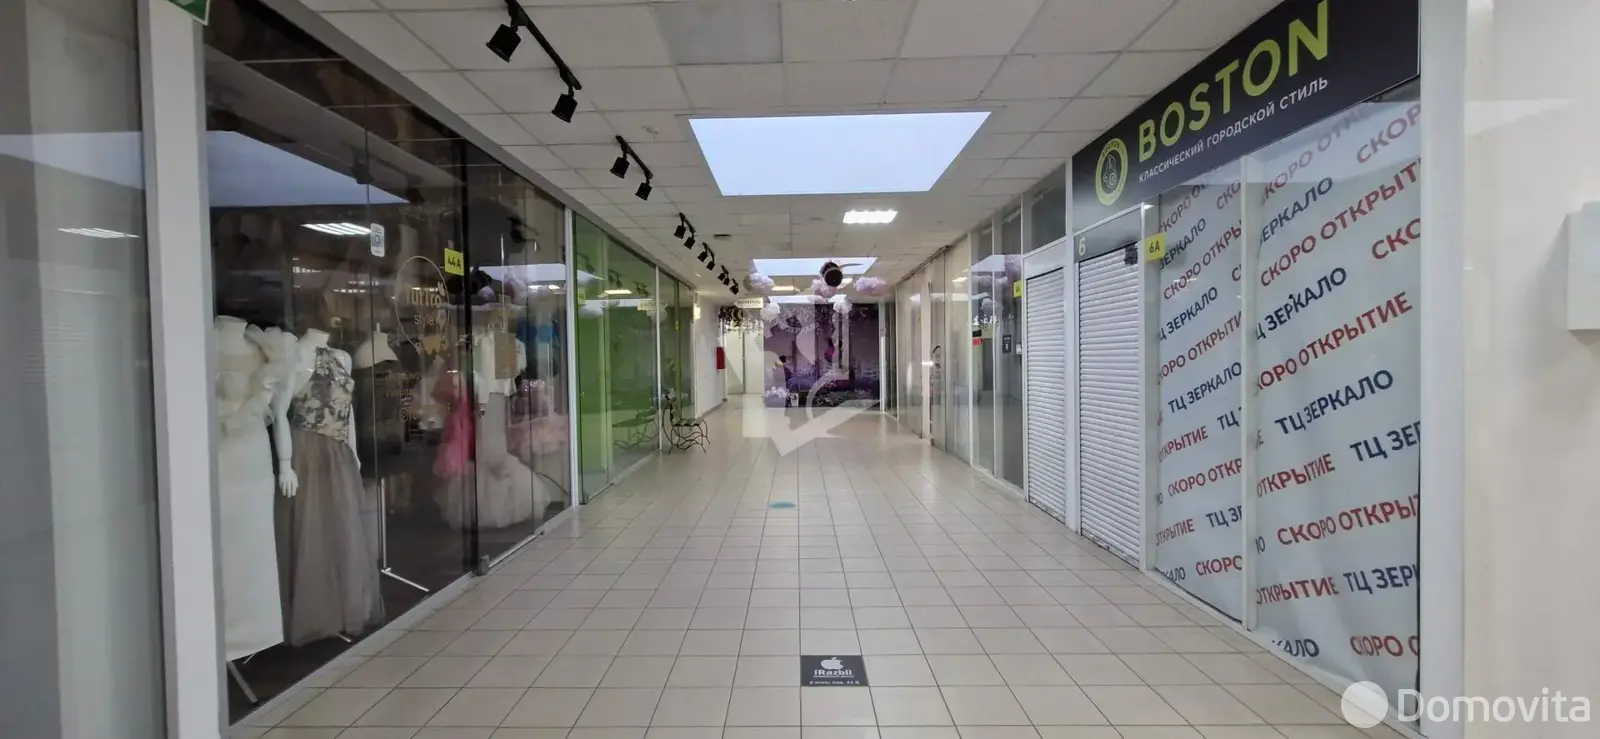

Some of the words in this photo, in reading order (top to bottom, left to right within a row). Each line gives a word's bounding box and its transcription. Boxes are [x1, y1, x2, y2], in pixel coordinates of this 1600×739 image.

[1138, 0, 1329, 163] BOSTON
[1138, 140, 1204, 183] КЛАССИЧЕСКИЙ
[1206, 101, 1275, 148] ГОРОДСКОЙ
[1279, 77, 1329, 110] СТИЛЬ
[1261, 151, 1313, 204] КОРО
[1078, 236, 1086, 256] 6
[1260, 235, 1316, 287] СКОРО
[1163, 263, 1201, 300] СКОРО
[1264, 267, 1347, 332] ЗЕРКАЛО
[1167, 286, 1218, 335] ЗЕРКАЛО
[1298, 291, 1413, 366] ОТКРЫТИЕ
[1168, 396, 1187, 413] ТЦ
[1187, 362, 1242, 404] ЗЕРКАЛО
[1274, 411, 1306, 435] ТЦ
[1303, 369, 1394, 424] ЗЕРКАЛО
[1217, 410, 1240, 430] ТЦ
[1349, 436, 1387, 462] ТЦ
[1168, 472, 1206, 497] СКОРО
[1256, 453, 1336, 498] ОТКРЫТИЕ
[1205, 510, 1229, 528] ТЦ
[1277, 516, 1337, 546] СКОРО
[1342, 570, 1373, 595] ТЦ
